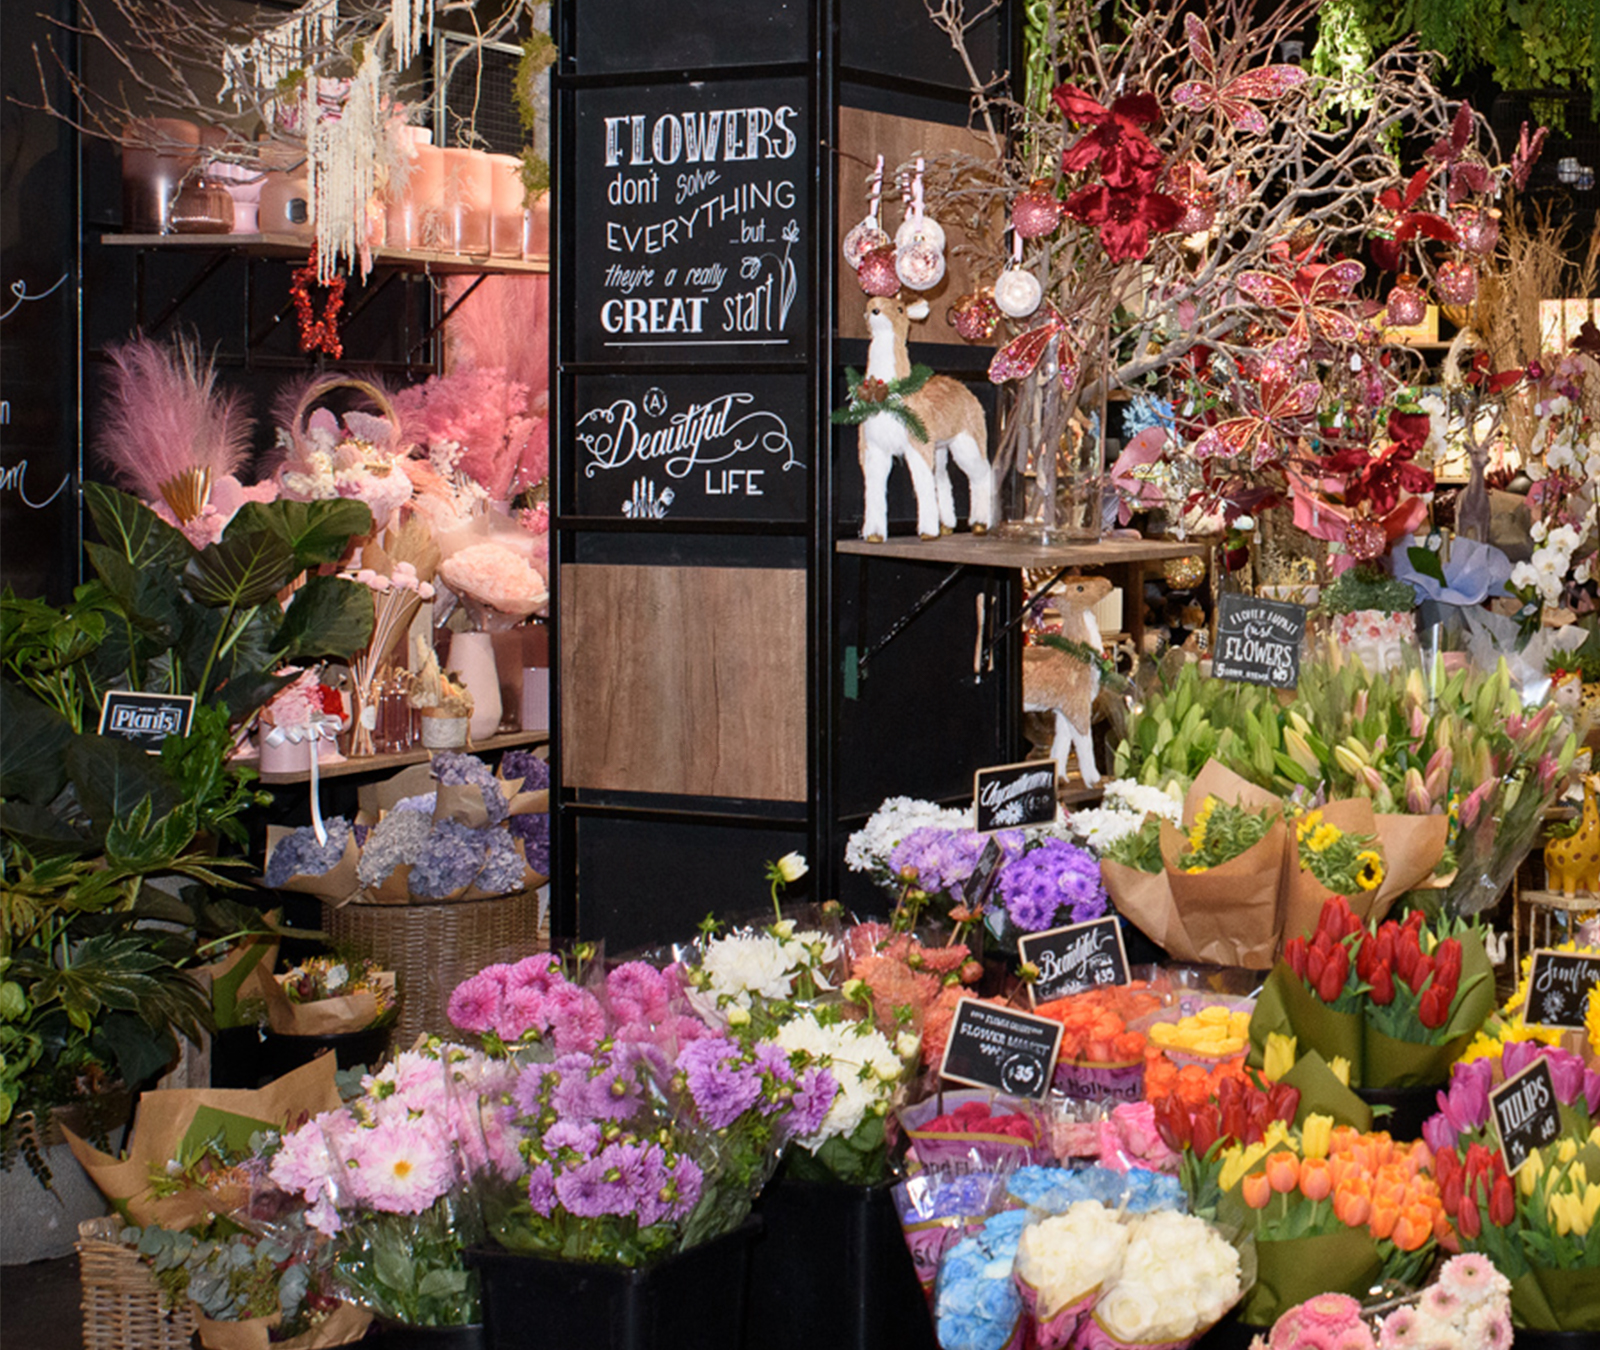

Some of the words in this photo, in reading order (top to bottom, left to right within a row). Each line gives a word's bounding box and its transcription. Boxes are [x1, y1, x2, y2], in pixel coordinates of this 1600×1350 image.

[604, 106, 798, 167] FLOWERS
[675, 168, 721, 205] solve
[606, 180, 796, 254] EVERYTHING
[664, 268, 678, 287] a
[684, 263, 728, 293] really
[600, 297, 709, 334] GREAT
[722, 273, 774, 332] start
[587, 392, 752, 478] Beautiful
[705, 469, 764, 495] LIFE
[1223, 636, 1292, 670] FLOWERS
[116, 709, 174, 732] Plants
[960, 1022, 1007, 1046] FLOWER
